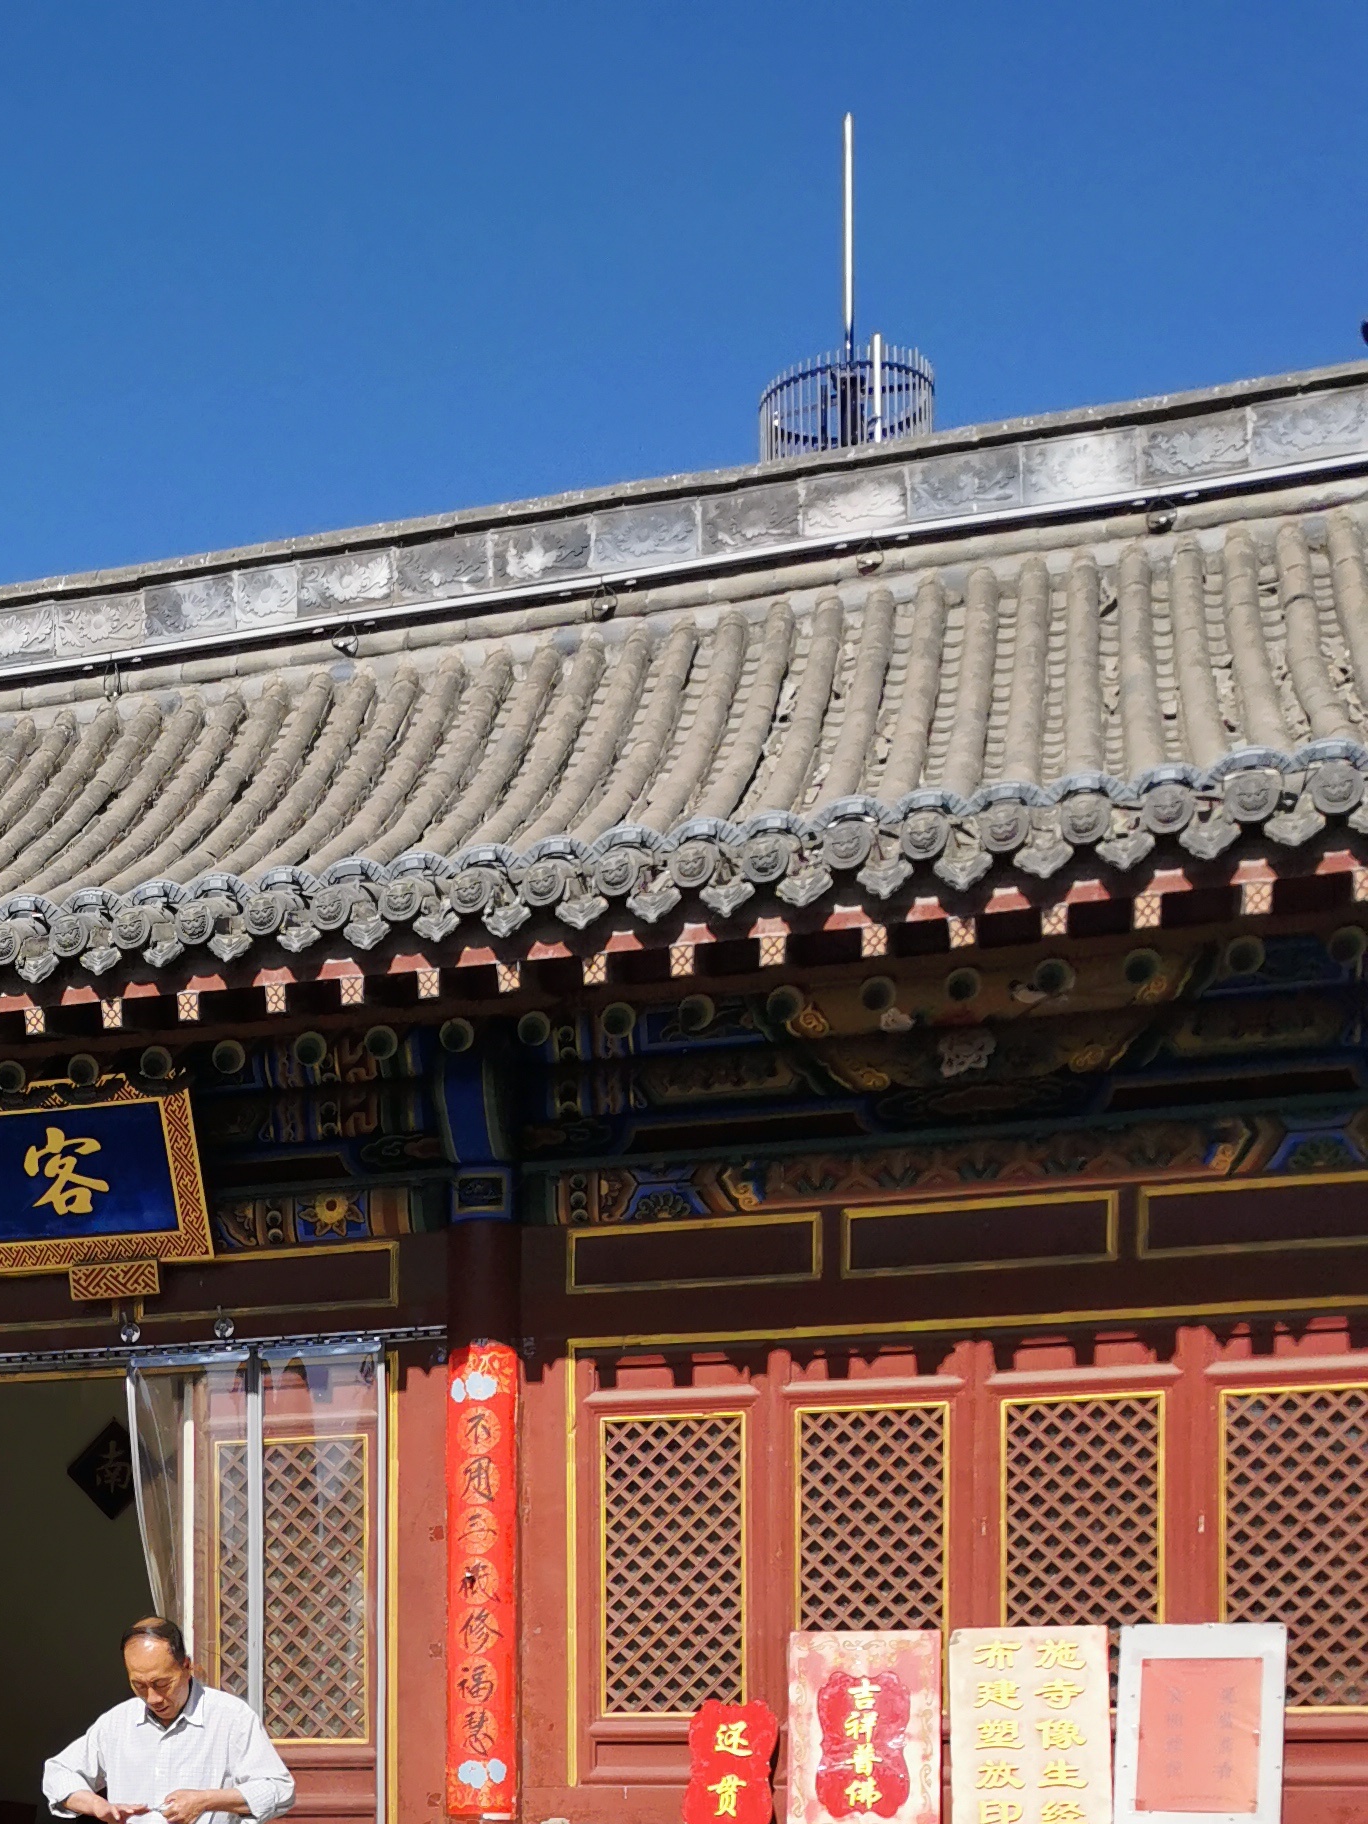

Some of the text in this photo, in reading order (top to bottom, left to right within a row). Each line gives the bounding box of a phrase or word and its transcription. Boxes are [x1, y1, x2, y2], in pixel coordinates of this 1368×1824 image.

[95, 1440, 133, 1493] 南
[972, 1639, 1087, 1670] 布施
[973, 1678, 1086, 1710] 建寺
[844, 1678, 883, 1810] 吉祥普佛
[974, 1718, 1087, 1750] 塑像
[975, 1758, 1089, 1789] 放生
